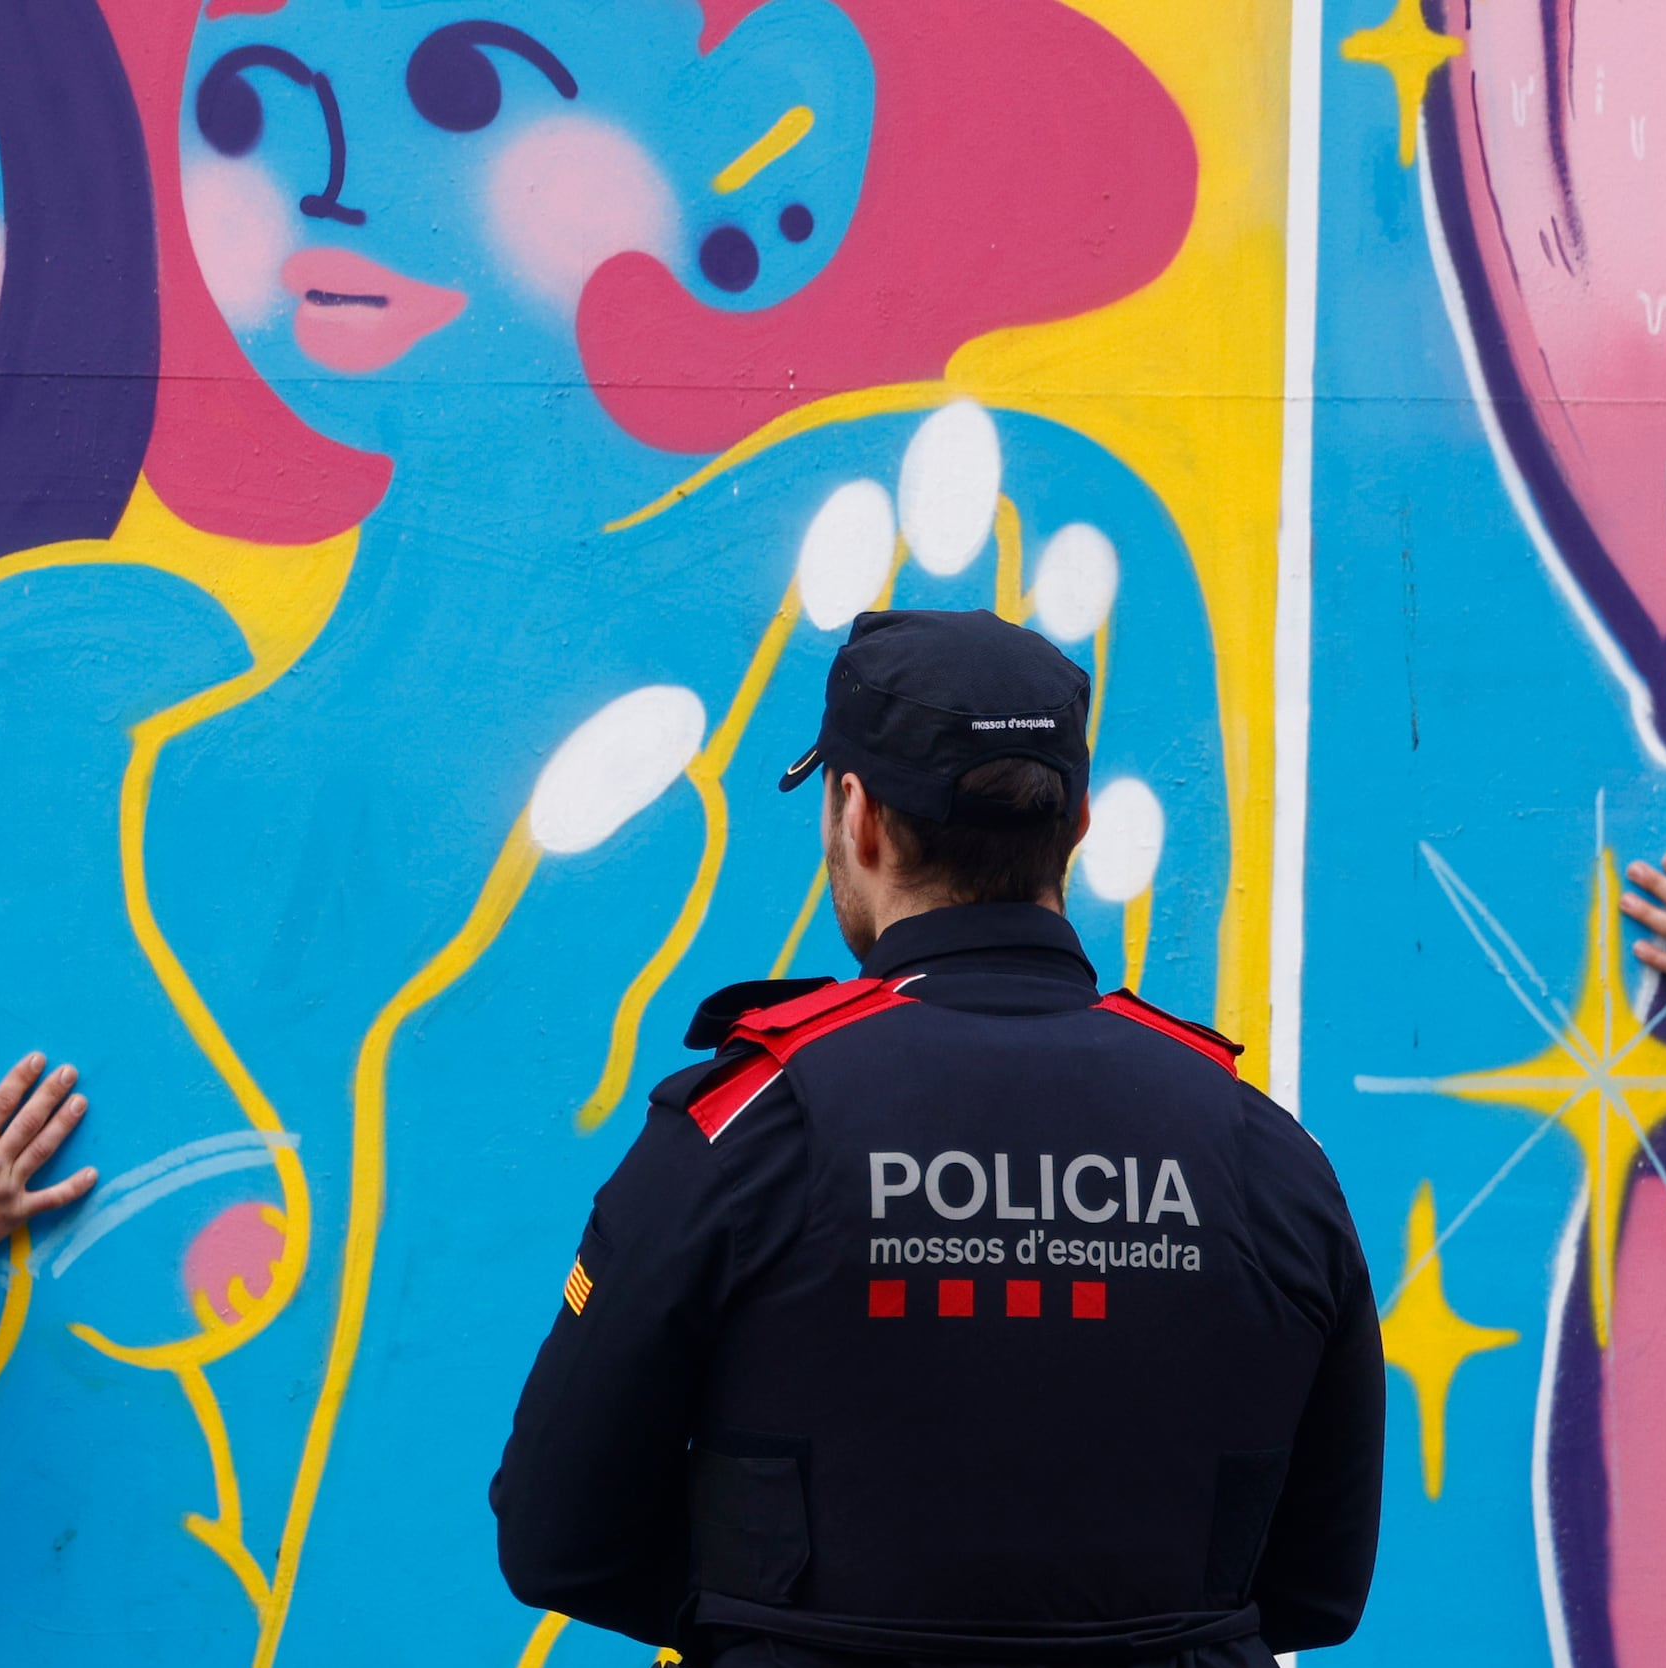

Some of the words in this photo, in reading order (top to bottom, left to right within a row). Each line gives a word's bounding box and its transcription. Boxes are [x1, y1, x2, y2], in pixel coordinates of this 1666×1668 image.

[869, 1151, 1201, 1226] POLICIA
[869, 1237, 1005, 1265] mossos
[1015, 1230, 1201, 1273] d'esquadra
